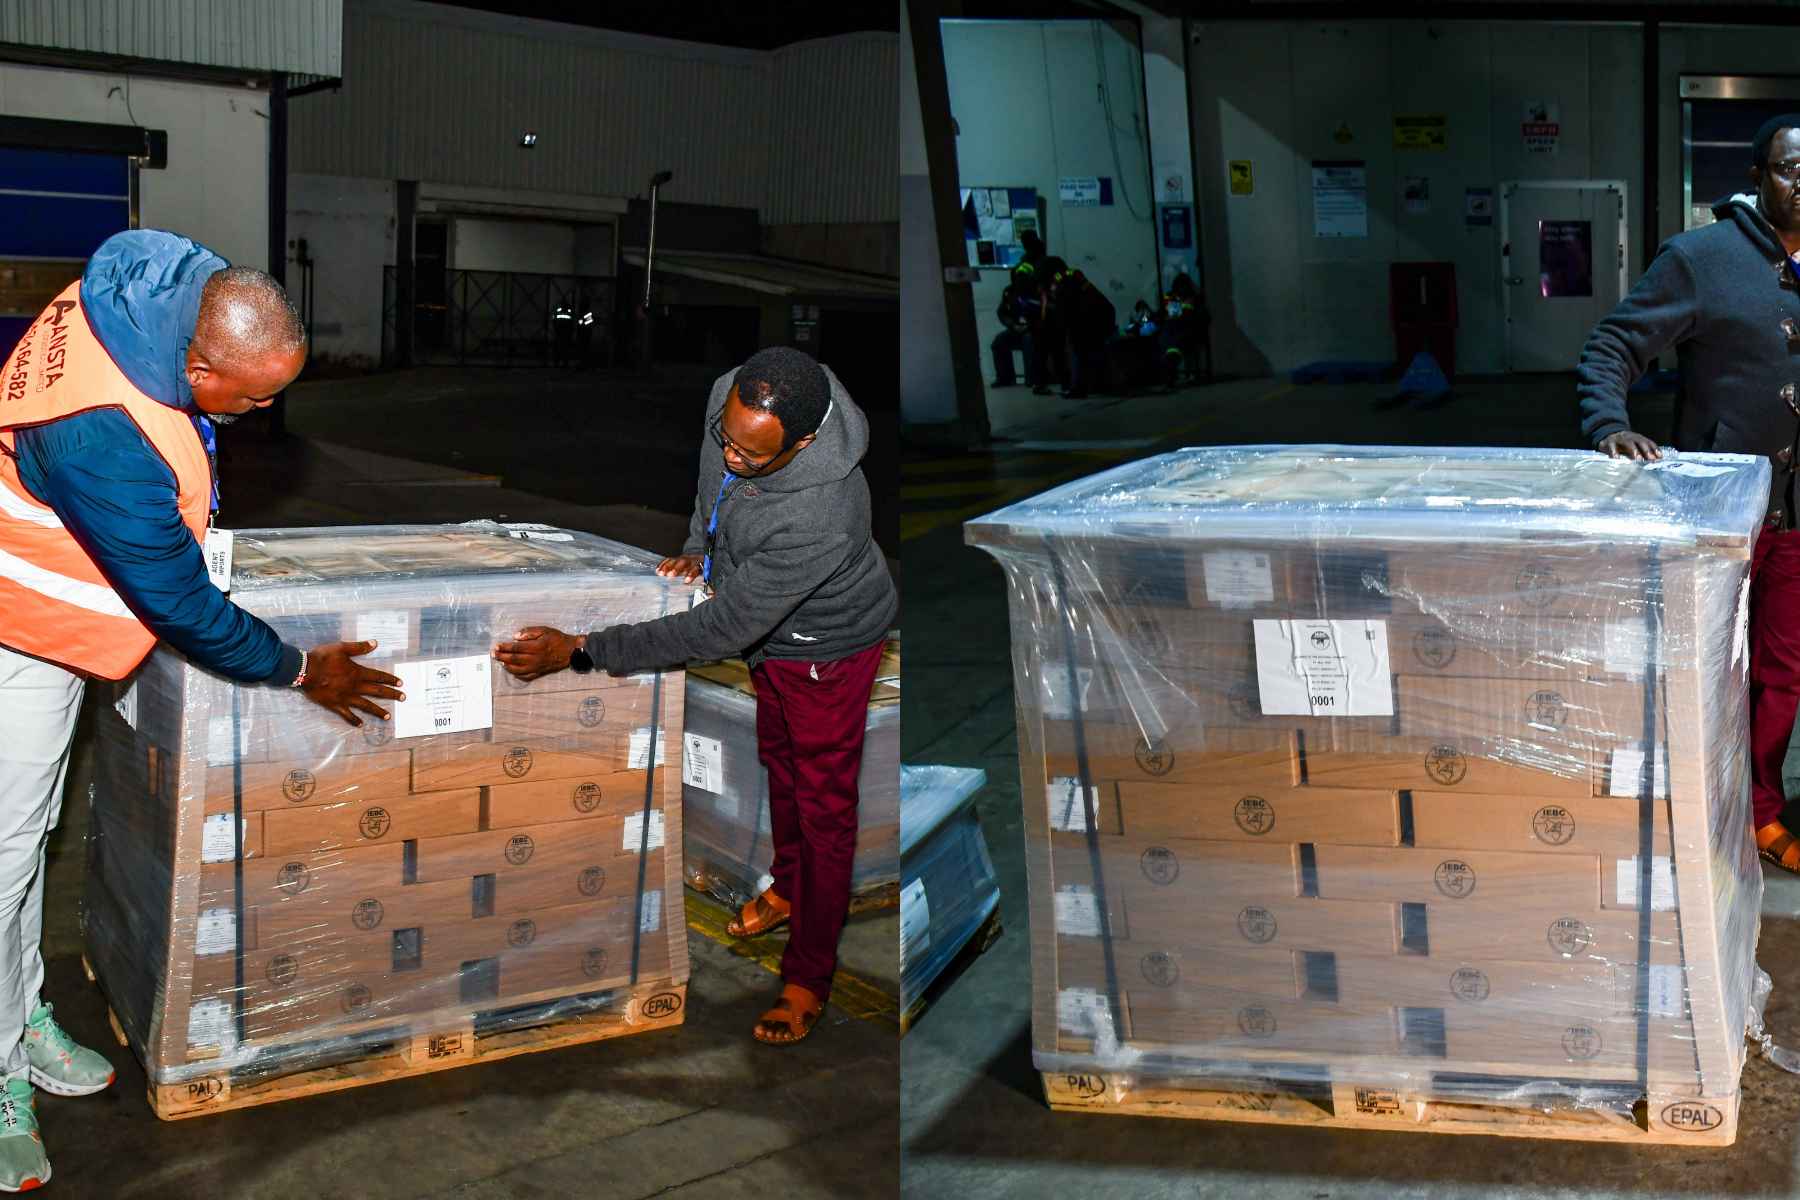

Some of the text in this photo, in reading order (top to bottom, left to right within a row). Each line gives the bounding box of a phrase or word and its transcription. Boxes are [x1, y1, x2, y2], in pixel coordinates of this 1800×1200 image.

[211, 552, 219, 574] AGENT
[1311, 696, 1335, 706] 0001
[1535, 692, 1561, 702] IEBC
[434, 718, 451, 727] 0001
[1242, 799, 1265, 808] IEBC
[367, 807, 385, 817] IEBC
[1542, 808, 1566, 817] IEBC
[284, 864, 303, 873] IEBC
[1444, 863, 1467, 872] IEBC
[648, 996, 674, 1014] EPAL
[1671, 1108, 1714, 1126] EPAL
